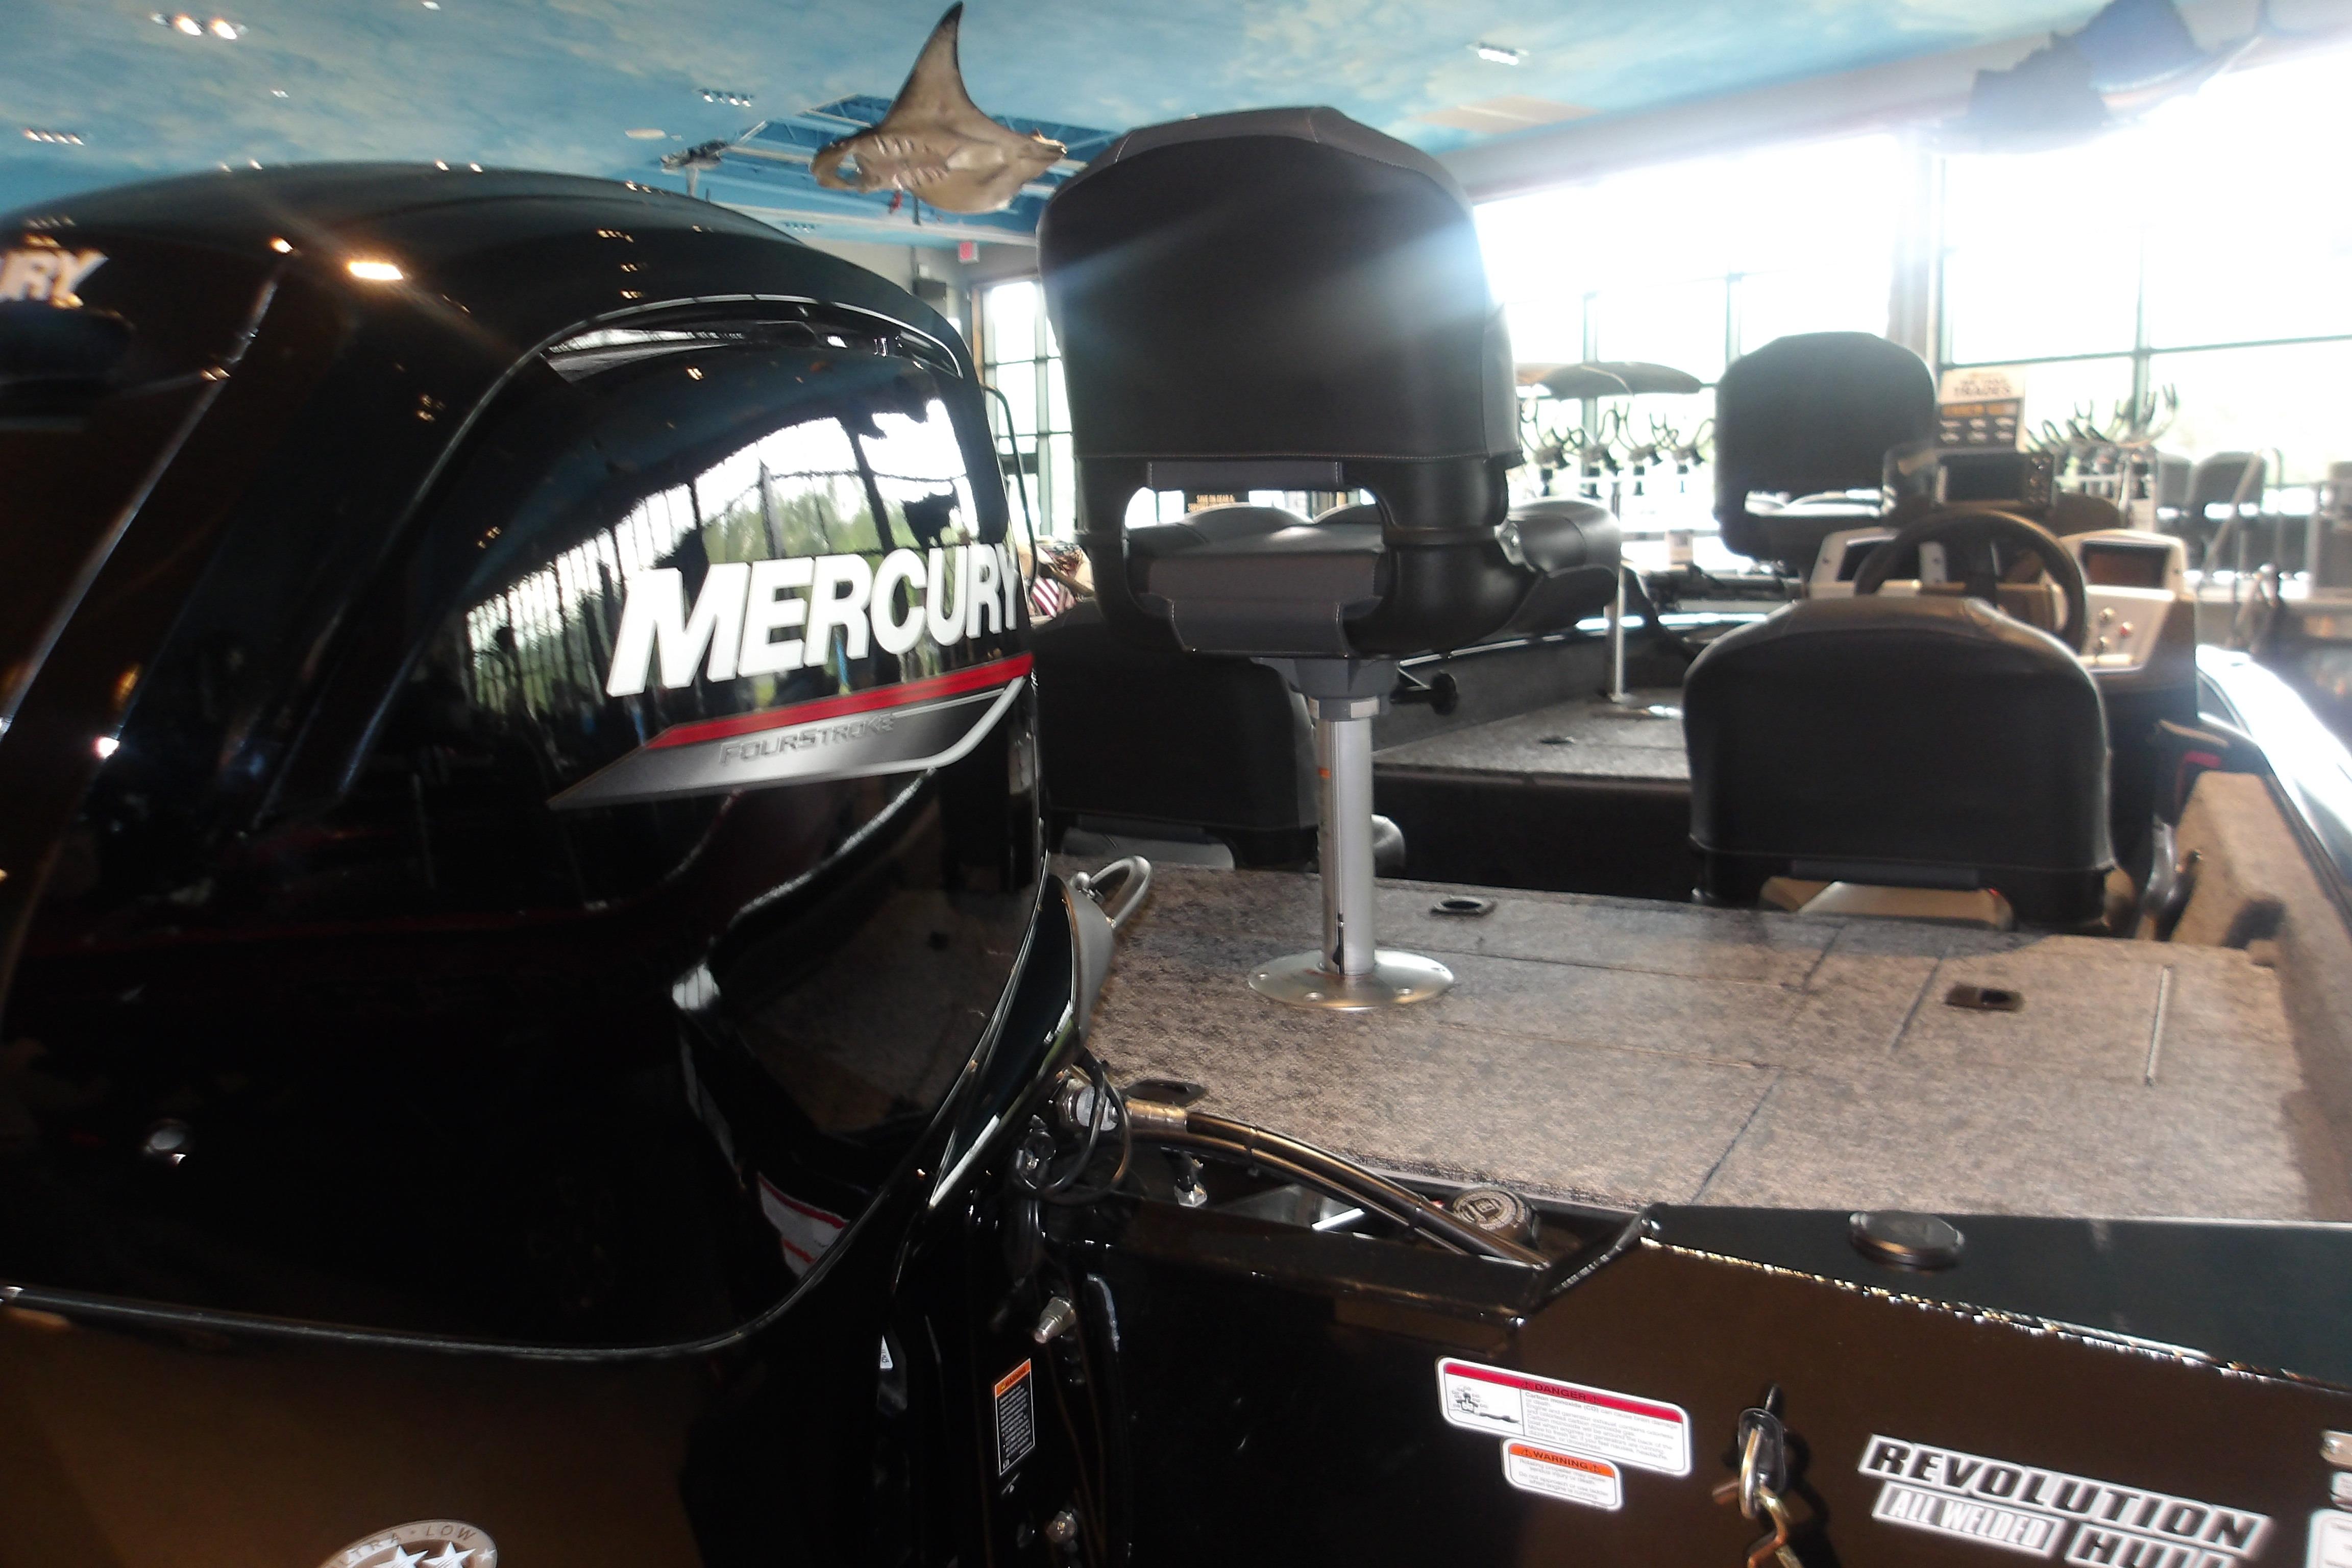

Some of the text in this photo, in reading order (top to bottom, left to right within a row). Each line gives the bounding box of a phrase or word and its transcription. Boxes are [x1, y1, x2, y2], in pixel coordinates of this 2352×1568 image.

[0, 249, 109, 308] RY
[606, 543, 1018, 697] MERCURY
[1534, 1383, 1586, 1401] DANGER
[1533, 1451, 1588, 1470] WARNING
[1867, 1439, 2259, 1549] REVOLUTION
[1890, 1489, 2049, 1549] ALL WELDED
[425, 1525, 477, 1541] LOW
